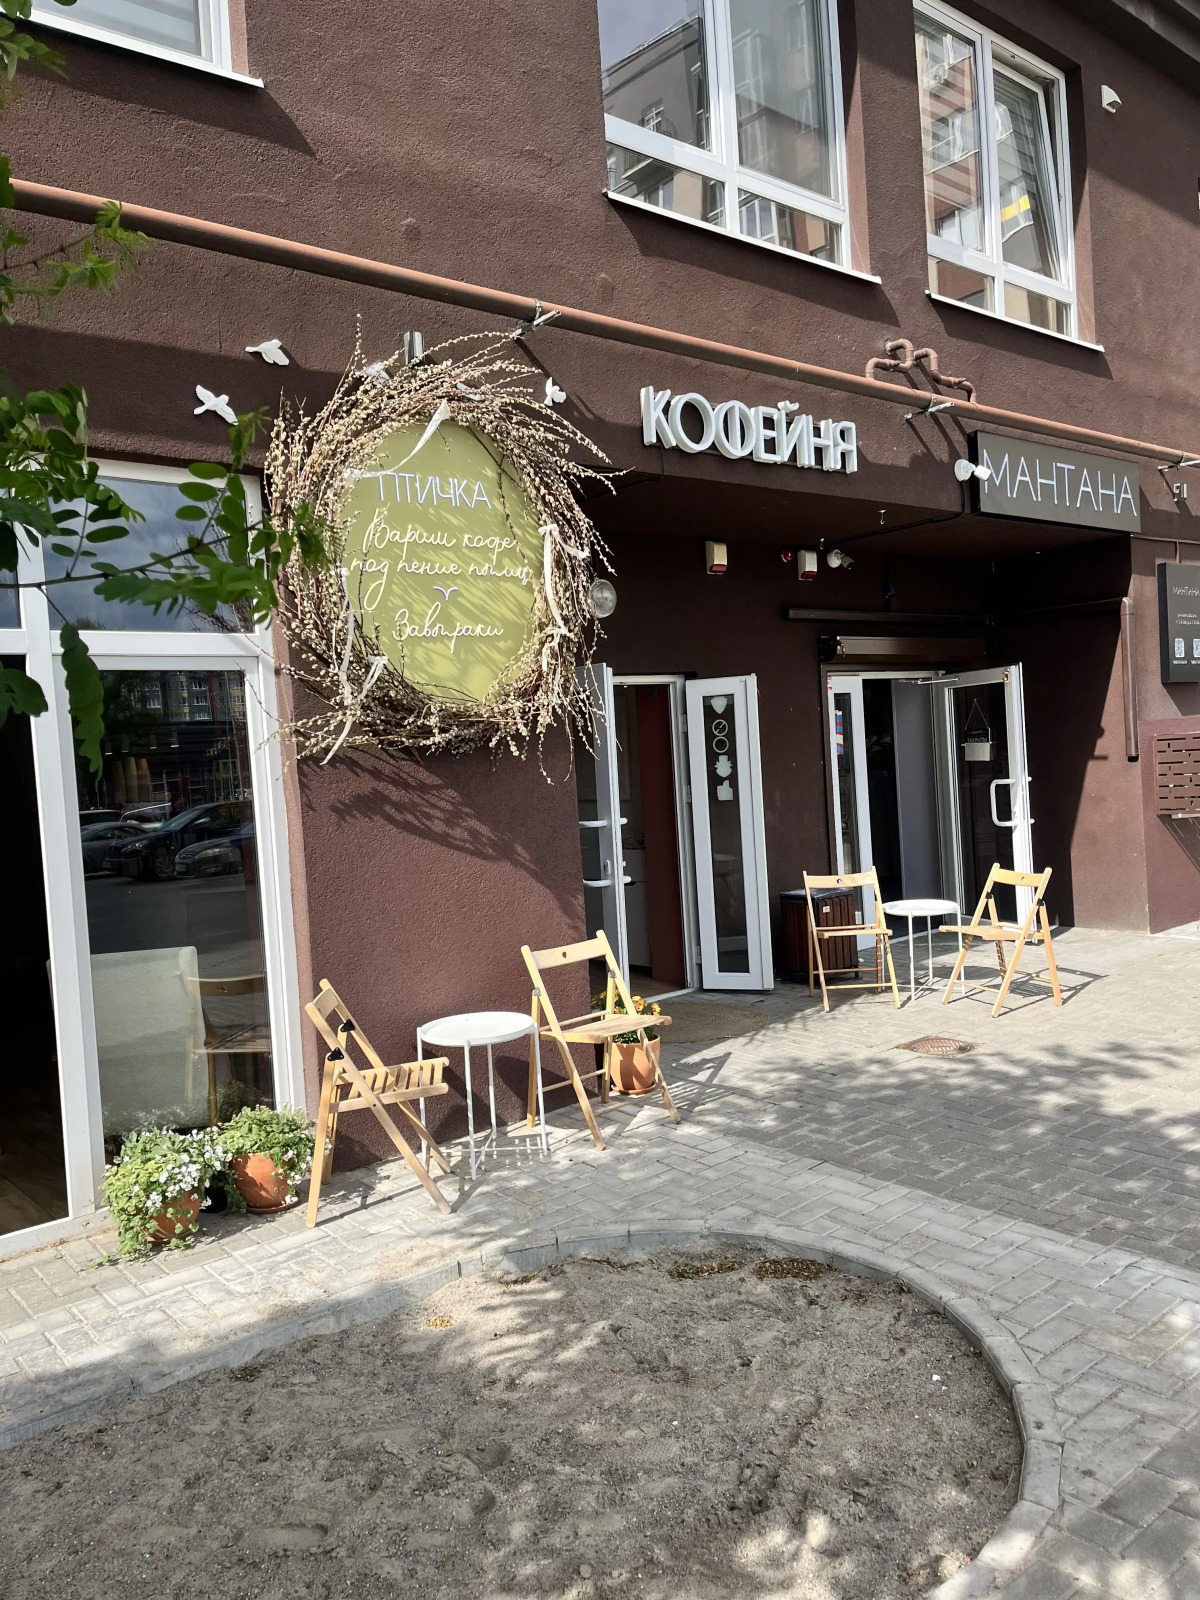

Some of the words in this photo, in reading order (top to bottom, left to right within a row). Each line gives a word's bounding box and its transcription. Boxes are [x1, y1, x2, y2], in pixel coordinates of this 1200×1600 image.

[640, 385, 858, 474] КОФЕЙНЯ
[378, 472, 493, 510] ПТИЧКА
[983, 449, 1138, 517] МАНТАНА
[364, 504, 456, 560] Варим
[463, 533, 518, 566] кофе
[350, 557, 390, 611] под
[397, 559, 462, 576] пение
[468, 565, 531, 586] птиц
[391, 602, 504, 654] Завтраки
